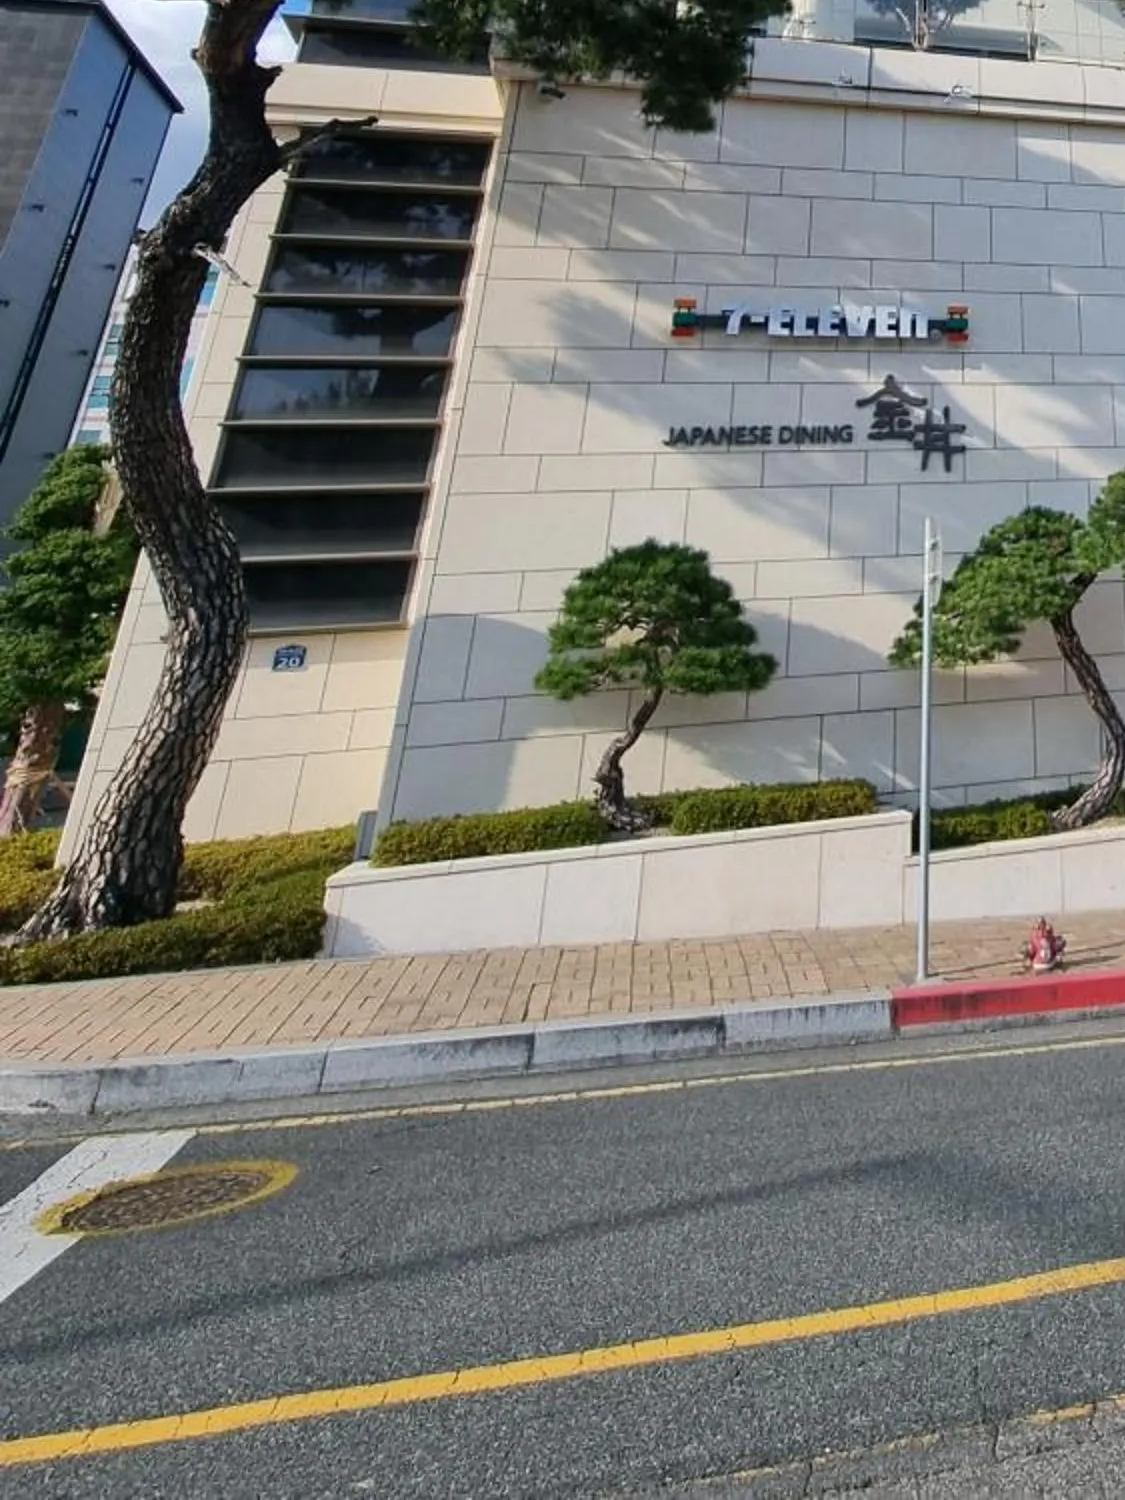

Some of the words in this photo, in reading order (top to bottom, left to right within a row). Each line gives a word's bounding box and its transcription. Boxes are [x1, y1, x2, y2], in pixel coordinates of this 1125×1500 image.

[663, 425, 773, 448] JAPANESE
[778, 424, 853, 445] DINING
[278, 657, 300, 668] 20
